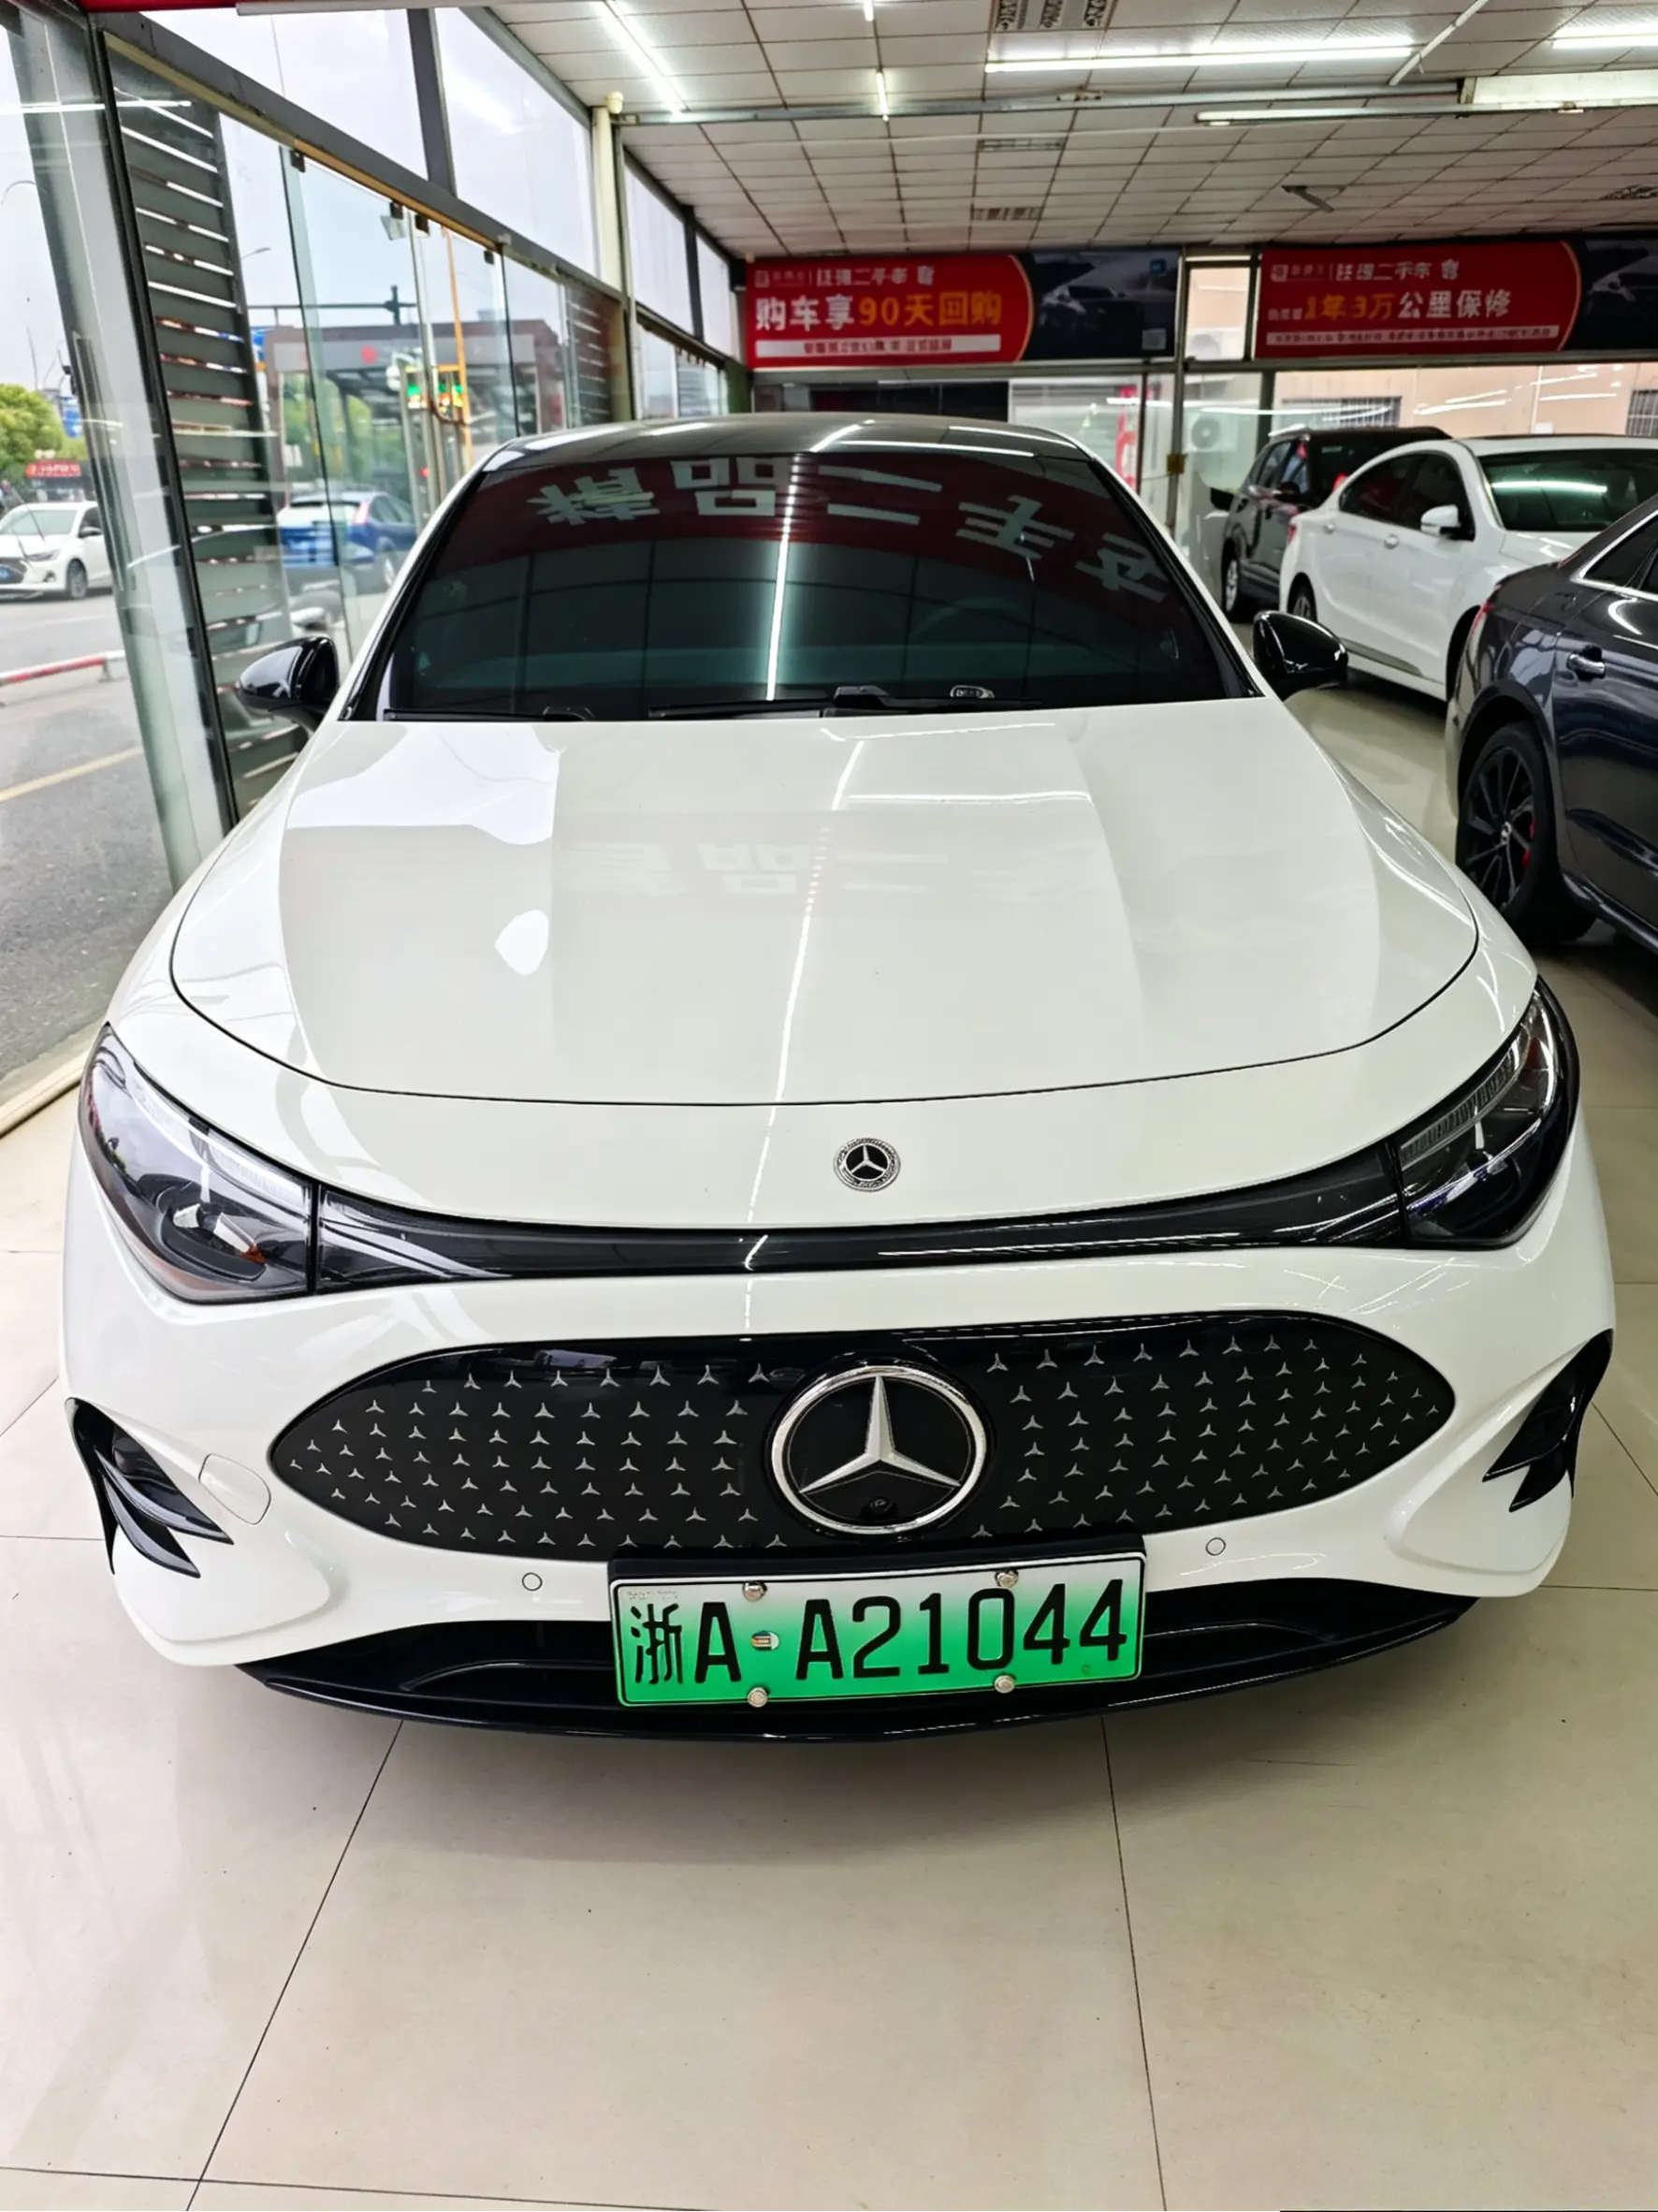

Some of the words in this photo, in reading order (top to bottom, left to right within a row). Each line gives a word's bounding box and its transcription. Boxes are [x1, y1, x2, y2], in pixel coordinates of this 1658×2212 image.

[755, 289, 1002, 331] 购车享90天回购
[1302, 288, 1512, 321] 1年3万公里保修
